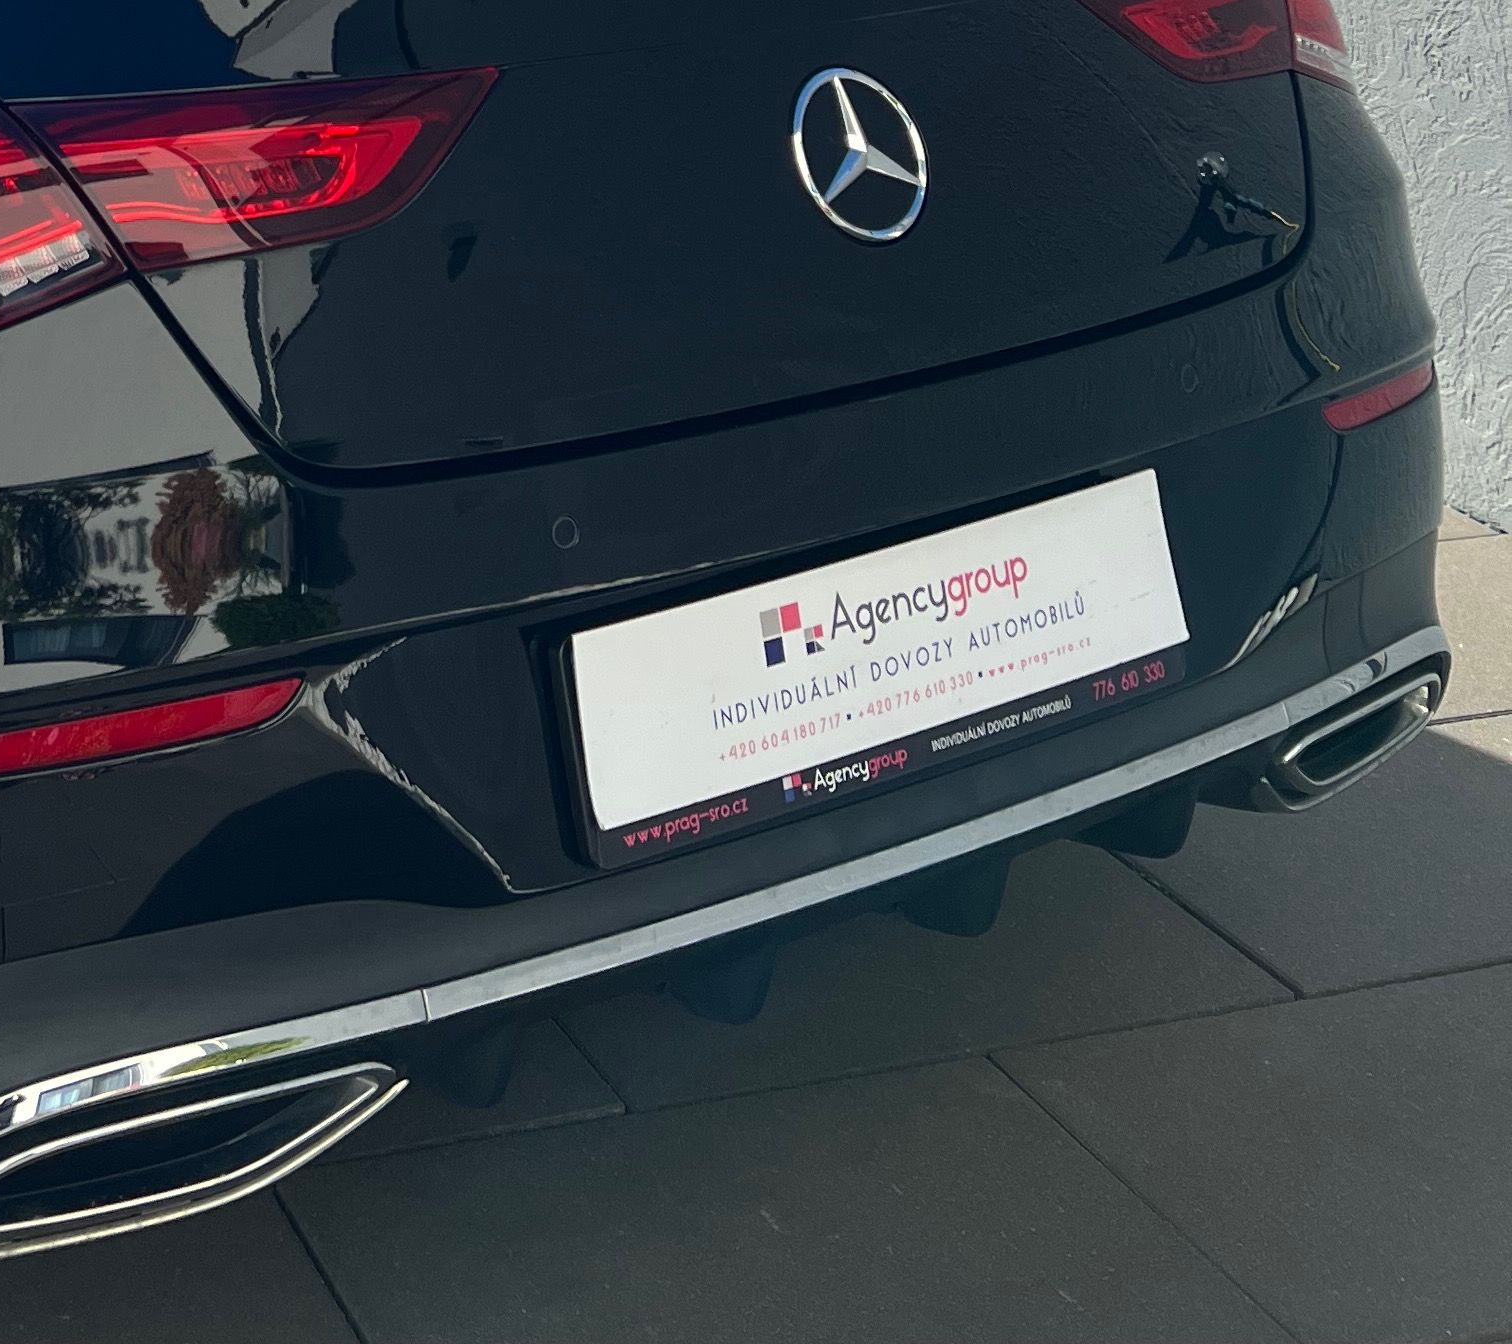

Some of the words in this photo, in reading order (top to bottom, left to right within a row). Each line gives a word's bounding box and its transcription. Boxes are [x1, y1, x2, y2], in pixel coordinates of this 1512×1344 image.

[831, 556, 1028, 645] Agencygroup
[712, 665, 858, 730] INDIVIDUÁLNÍ
[870, 638, 954, 682] DOVOZY
[969, 590, 1086, 652] AUTOMOBILŮ
[1092, 677, 1116, 701] 776
[1120, 669, 1140, 692] 610
[1143, 660, 1166, 684] 330
[719, 739, 757, 762] +420
[821, 713, 841, 733] 717
[858, 697, 892, 719] +420
[896, 687, 921, 708] 776
[926, 677, 946, 699] 610
[950, 671, 974, 690] 330
[931, 721, 987, 752] INDIVIDUÁLNÍ
[987, 713, 1021, 735] DOVOZY
[1021, 694, 1072, 722] AUTOMOBILŮ
[813, 749, 908, 793] Agencygroup
[623, 798, 749, 848] www.prag-sro.cz
